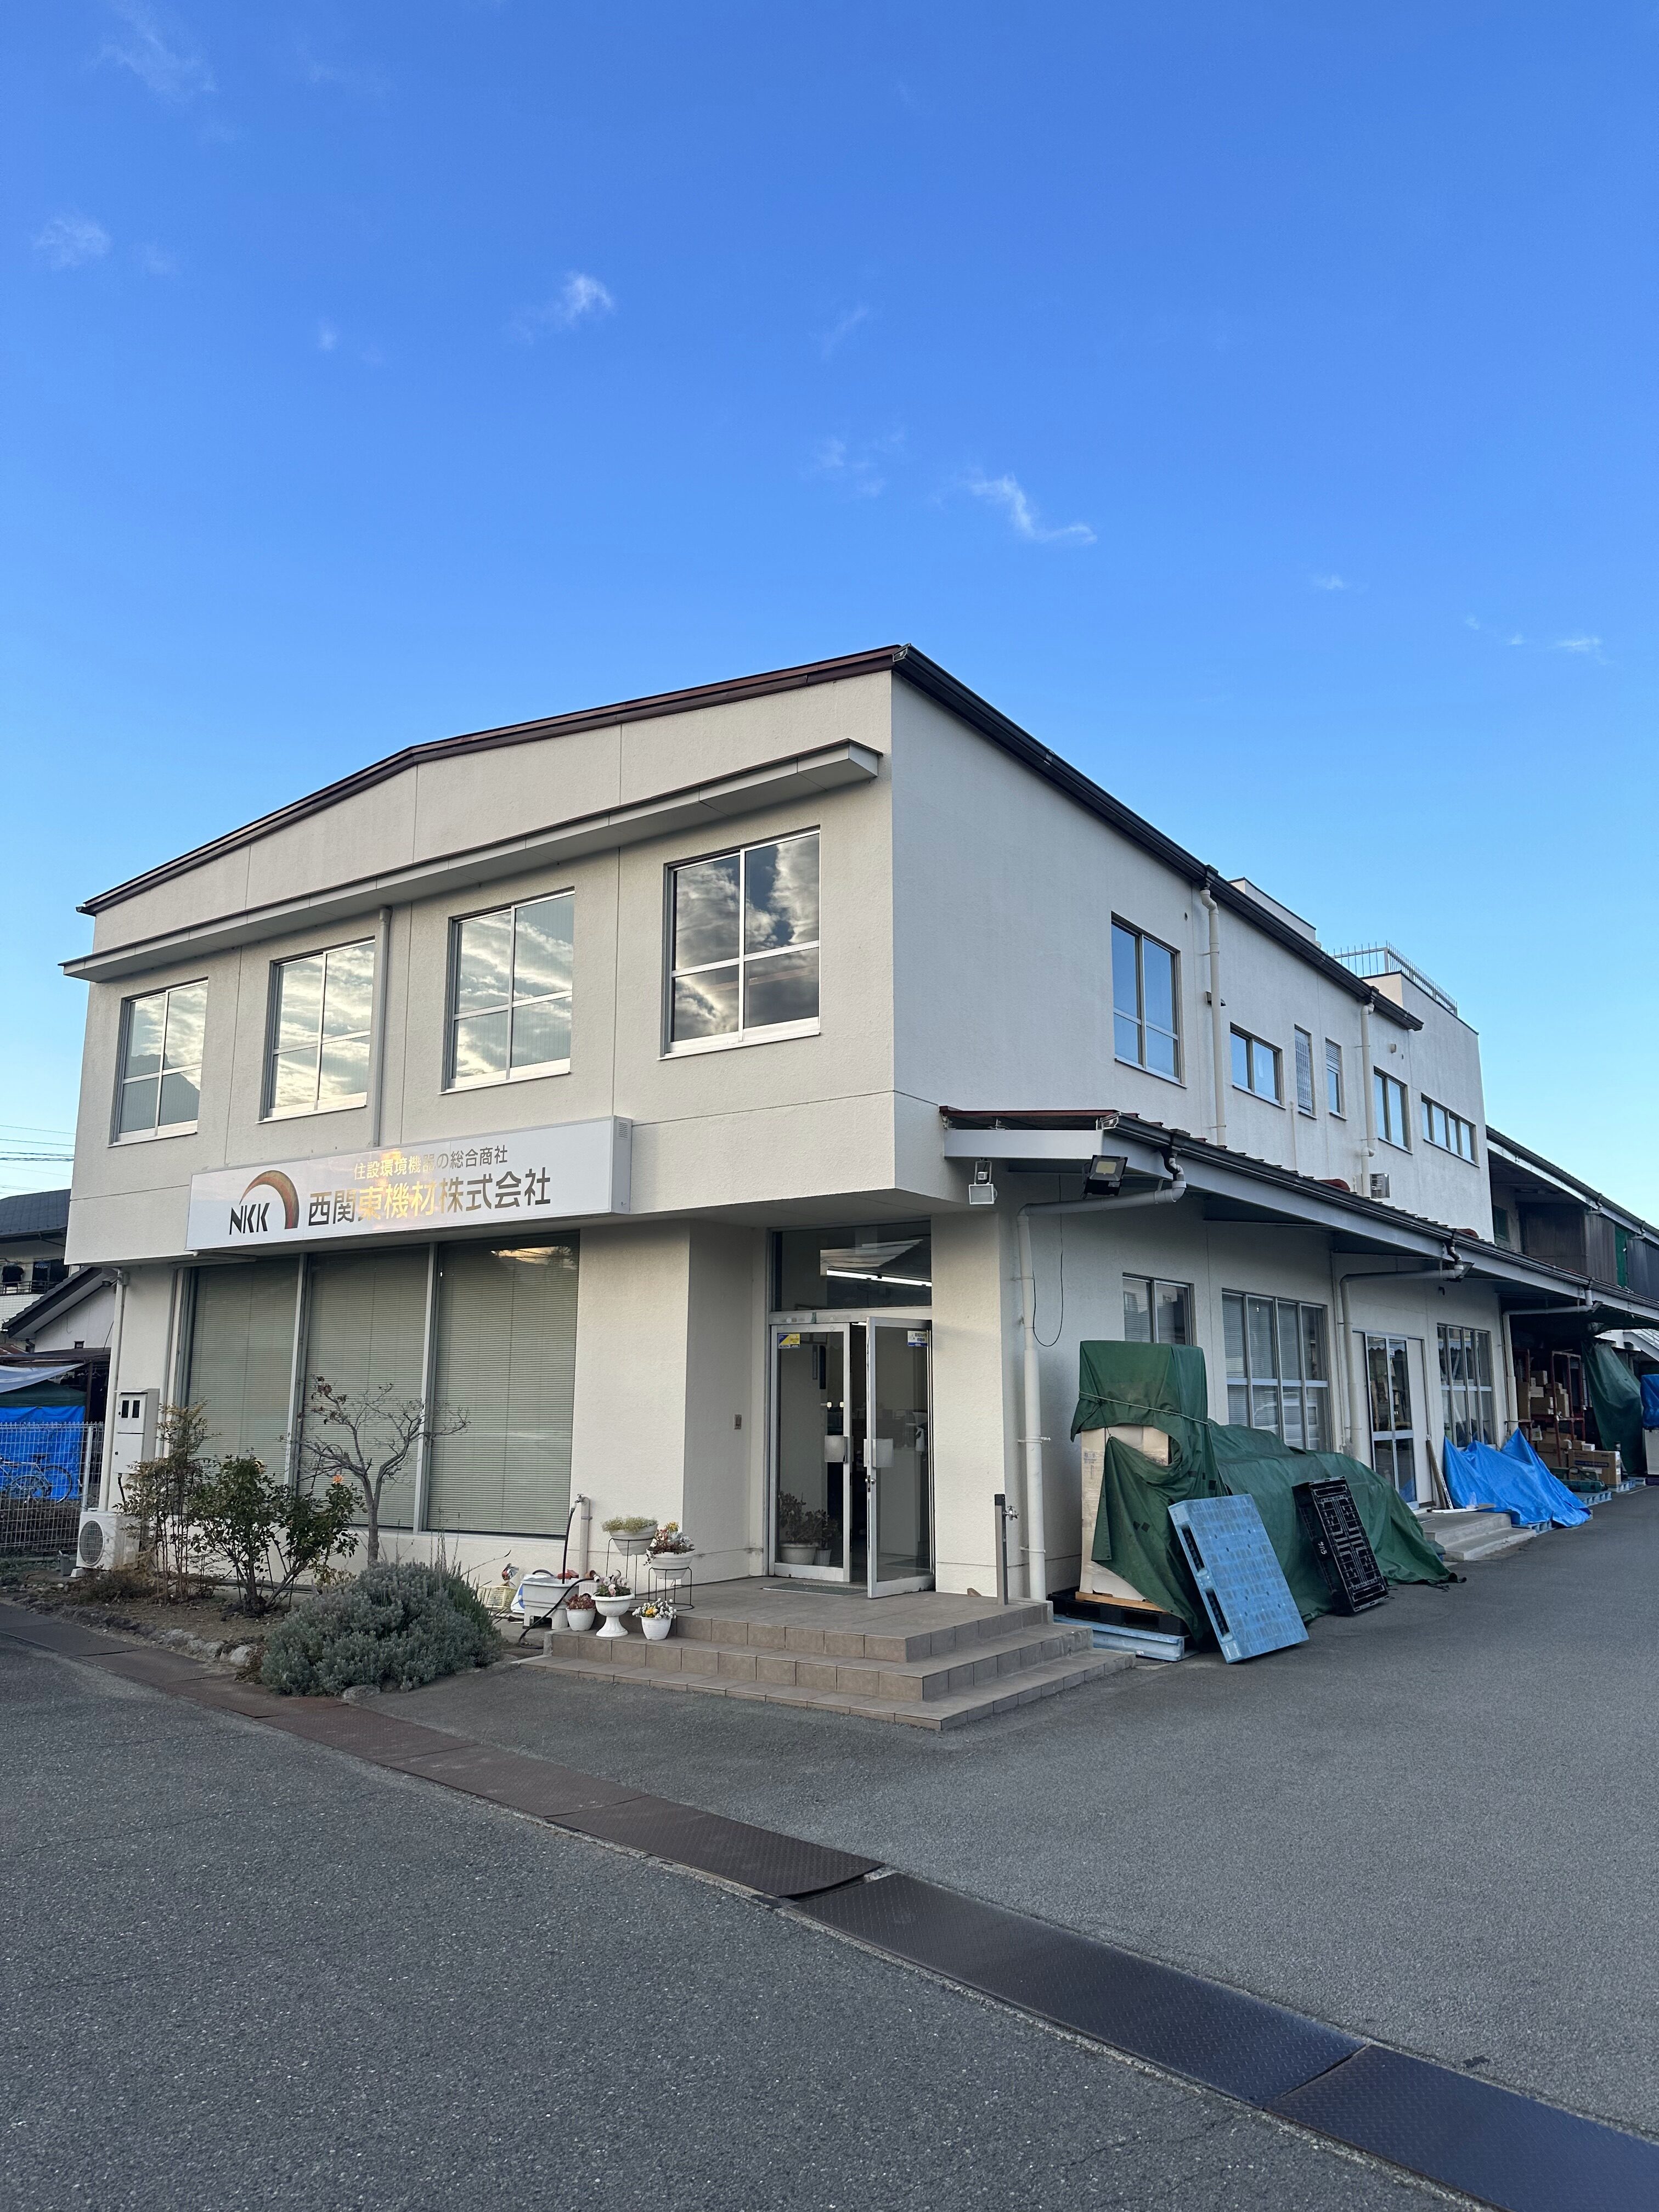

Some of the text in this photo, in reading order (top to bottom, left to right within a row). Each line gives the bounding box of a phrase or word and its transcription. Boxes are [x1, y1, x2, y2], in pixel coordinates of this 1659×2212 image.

[353, 1145, 508, 1180] 住設環境機器の総合商社
[308, 1166, 551, 1226] 西関東機材株式会社
[229, 1203, 270, 1235] NKK
